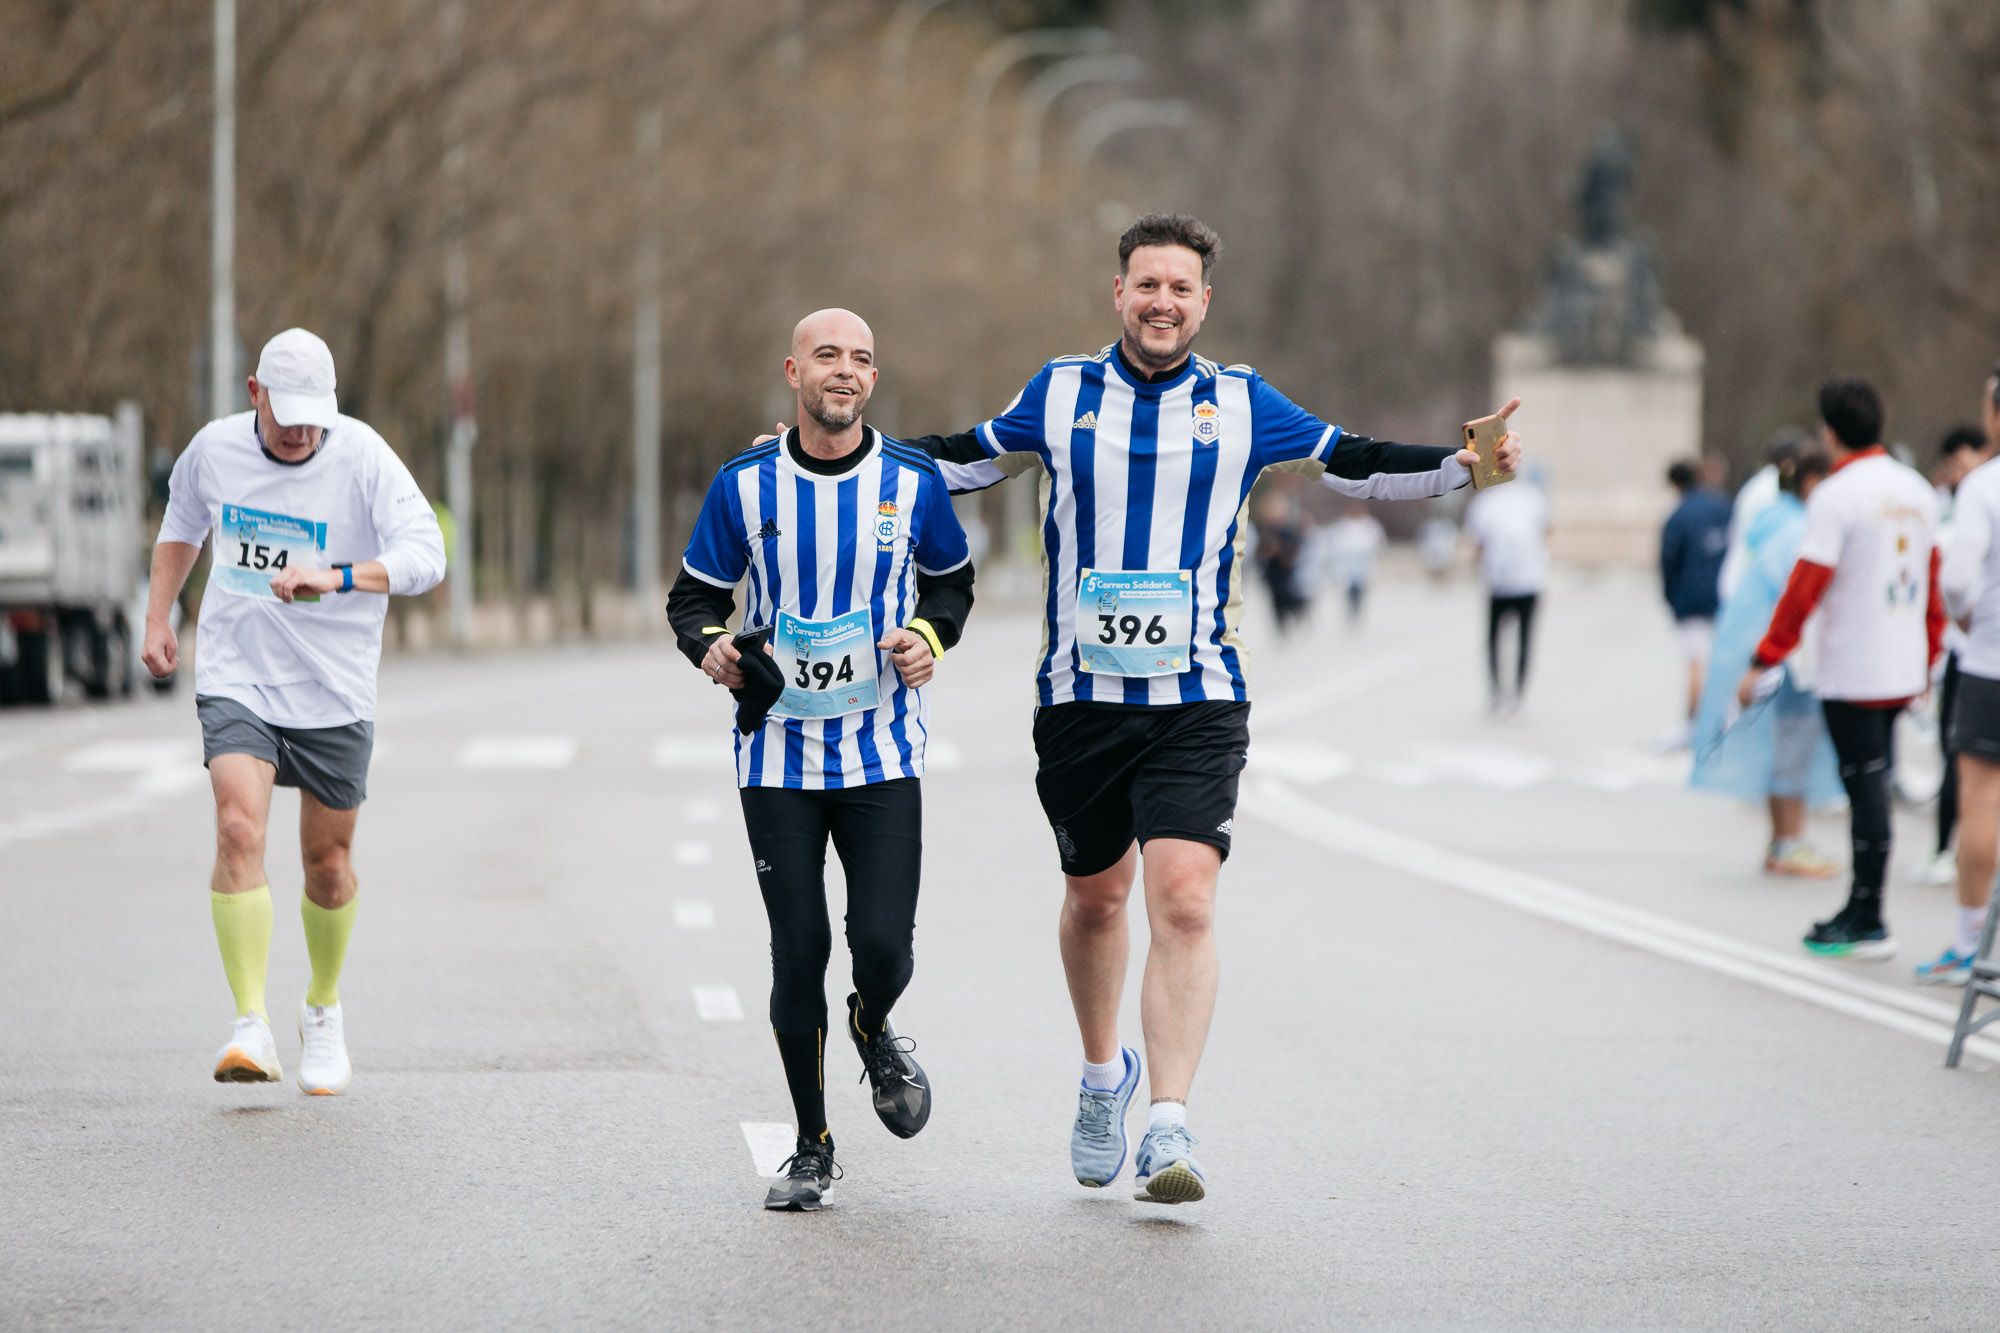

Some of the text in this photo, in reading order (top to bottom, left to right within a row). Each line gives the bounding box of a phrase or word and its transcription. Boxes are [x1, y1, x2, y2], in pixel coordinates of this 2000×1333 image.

[237, 542, 288, 571] 154
[1097, 580, 1131, 589] Carrera
[1132, 580, 1172, 589] Solidaria
[793, 625, 821, 637] Carrera
[823, 621, 855, 638] Solidaria
[1098, 614, 1167, 645] 396
[795, 653, 854, 691] 394
[847, 696, 859, 705] CSL
